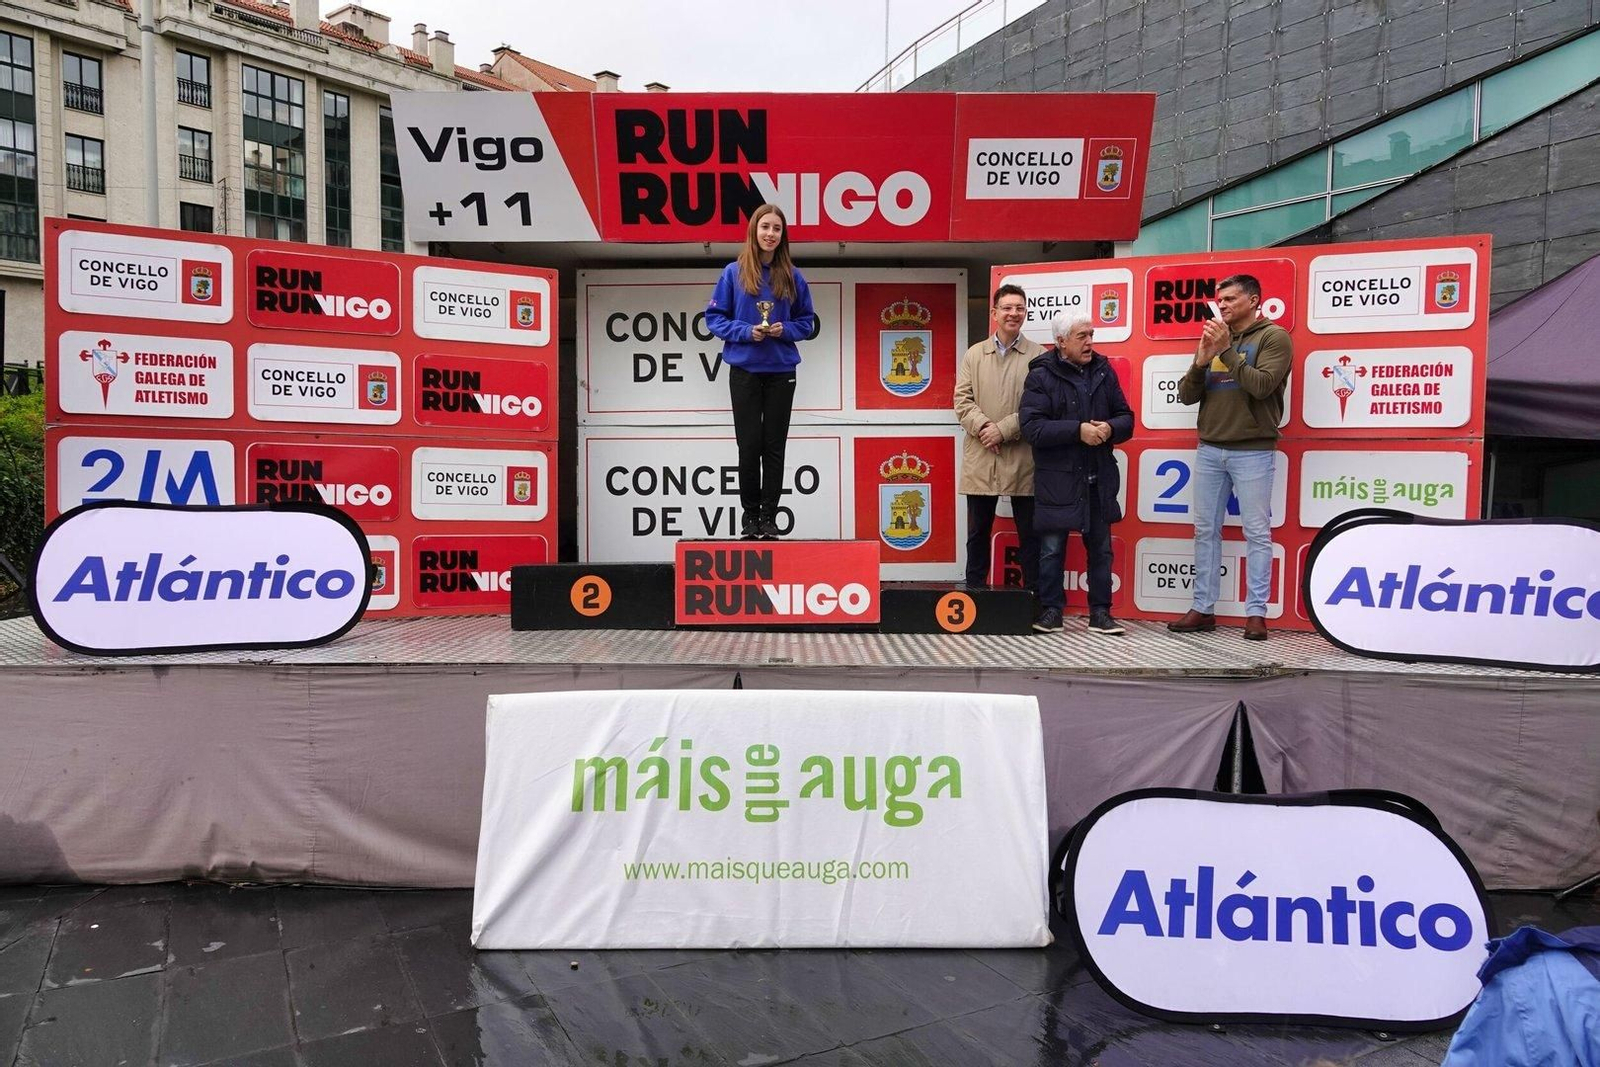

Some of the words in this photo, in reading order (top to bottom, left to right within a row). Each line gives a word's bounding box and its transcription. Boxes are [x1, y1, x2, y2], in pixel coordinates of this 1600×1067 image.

[615, 109, 767, 165] RUN
[407, 127, 543, 171] Vigo
[976, 151, 1074, 168] CONCELLO
[987, 171, 1010, 186] DE
[1017, 170, 1061, 187] VIGO
[429, 192, 532, 226] +11
[619, 172, 768, 226] RUN
[79, 259, 169, 278] CONCELLO
[256, 266, 322, 292] RUN
[90, 275, 112, 288] DE
[119, 277, 158, 292] VIGO
[1154, 278, 1216, 301] RUN
[1322, 277, 1411, 292] CONCELLO
[256, 290, 325, 315] RUN
[313, 294, 391, 320] VIGO
[429, 291, 500, 308] CONCELLO
[1027, 294, 1081, 307] NCELLO
[1331, 295, 1353, 308] DE
[1359, 293, 1401, 307] VIGO
[438, 305, 455, 316] DE
[460, 306, 492, 319] VIGO
[1026, 311, 1035, 321] E
[1039, 309, 1062, 320] VI
[1153, 301, 1216, 324] RUN
[134, 352, 217, 369] FEDERACIÓN
[633, 352, 683, 383] DE
[1371, 362, 1454, 378] FEDERACIÓN
[134, 371, 186, 386] GALEGA
[189, 373, 206, 387] DE
[261, 369, 346, 384] CONCELLO
[421, 368, 481, 391] RUN
[134, 389, 208, 405] ATLETISMO
[272, 384, 291, 396] DE
[298, 385, 337, 398] VIGO
[1371, 383, 1420, 397] GALEGA
[1422, 383, 1441, 396] DE
[421, 391, 482, 414] RUN
[473, 393, 542, 417] VIGO
[1369, 402, 1443, 415] ATLETISMO
[256, 459, 322, 481] RUN
[427, 472, 497, 484] CONCELLO
[605, 465, 820, 496] CONCEO
[314, 483, 392, 506] VIGO
[436, 485, 452, 495] DE
[458, 486, 489, 497] VIGO
[1312, 476, 1368, 500] máis
[1373, 478, 1389, 504] que
[1392, 483, 1454, 506] auga
[632, 507, 683, 536] DE
[698, 506, 795, 536] VIO
[421, 550, 478, 570] RUN
[684, 550, 773, 581] RUN
[1149, 563, 1228, 577] CONCEO
[52, 553, 355, 602] Atlántico
[420, 572, 479, 593] RUN
[1157, 577, 1176, 589] DE
[582, 583, 600, 609] 2
[684, 584, 777, 616] RUN
[762, 583, 871, 616] VIGO
[947, 599, 965, 624] 3
[571, 737, 731, 812] máis
[744, 743, 789, 823] que
[799, 755, 962, 828] auga
[623, 857, 909, 884] www.maisqueauga.com
[1097, 866, 1473, 951] Atlántico
